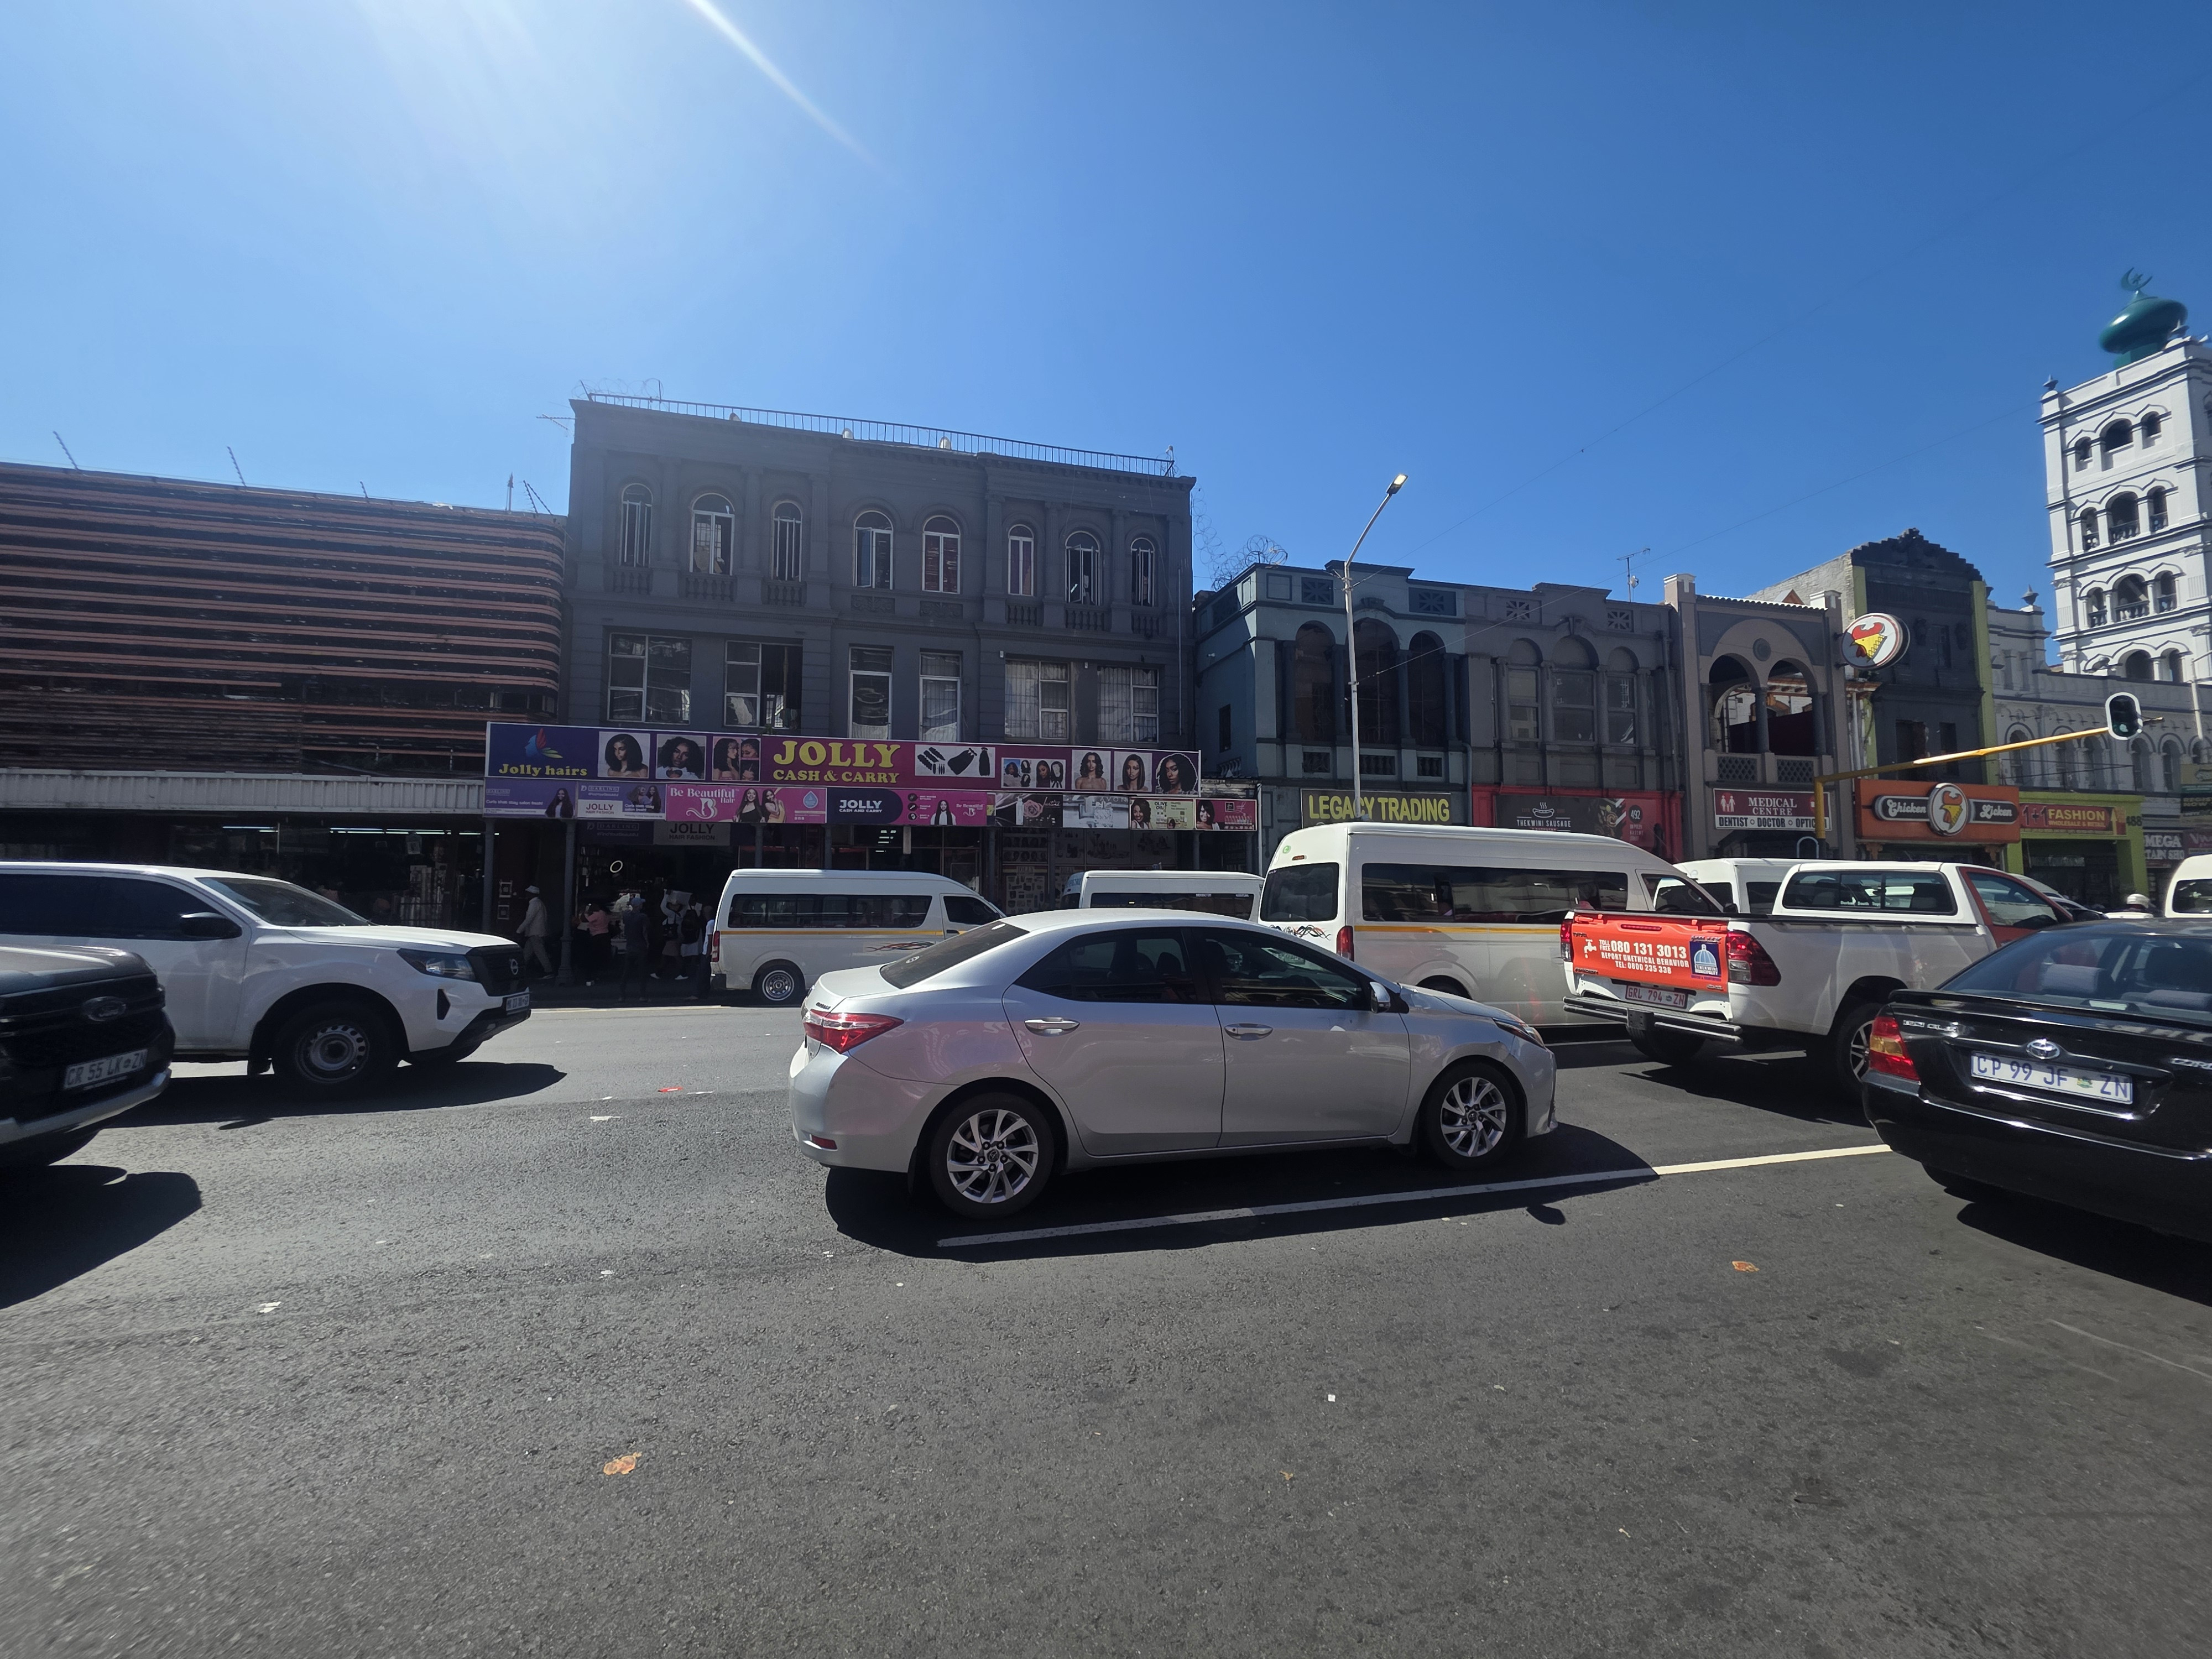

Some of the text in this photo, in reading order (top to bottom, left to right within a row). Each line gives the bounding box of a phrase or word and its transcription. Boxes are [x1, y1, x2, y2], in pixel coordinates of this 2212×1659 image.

[773, 740, 901, 768] JOLLY
[499, 764, 587, 776] Jolly hairs
[773, 769, 900, 783] CASH & CARRY
[670, 787, 735, 798] Be Beautiful
[839, 800, 882, 808] JOLLY
[1309, 795, 1450, 822] LEGACY TRADING
[1748, 797, 1797, 808] MEDICAL
[1630, 810, 1641, 819] 492
[1752, 807, 1792, 816] CENTRE
[1887, 799, 2012, 819] Chicken Licken
[2048, 809, 2105, 821] FASHION
[1719, 817, 1748, 827] DENTIST
[1757, 817, 1786, 827] DOCTOR
[2126, 816, 2142, 826] 488
[670, 823, 714, 833] JOLLY
[1611, 941, 1630, 953] 080
[1634, 942, 1653, 955] 131
[1657, 945, 1687, 959] 3013
[1601, 952, 1689, 968] REPORT UNETHICAL BEHAVIOR
[1658, 966, 1672, 974] 338
[1628, 987, 1685, 1005] GRL 794 ZN
[87, 1062, 104, 1081] 55
[132, 1052, 145, 1070] ZN
[1978, 1056, 2128, 1098] CP 99 JF ZN
